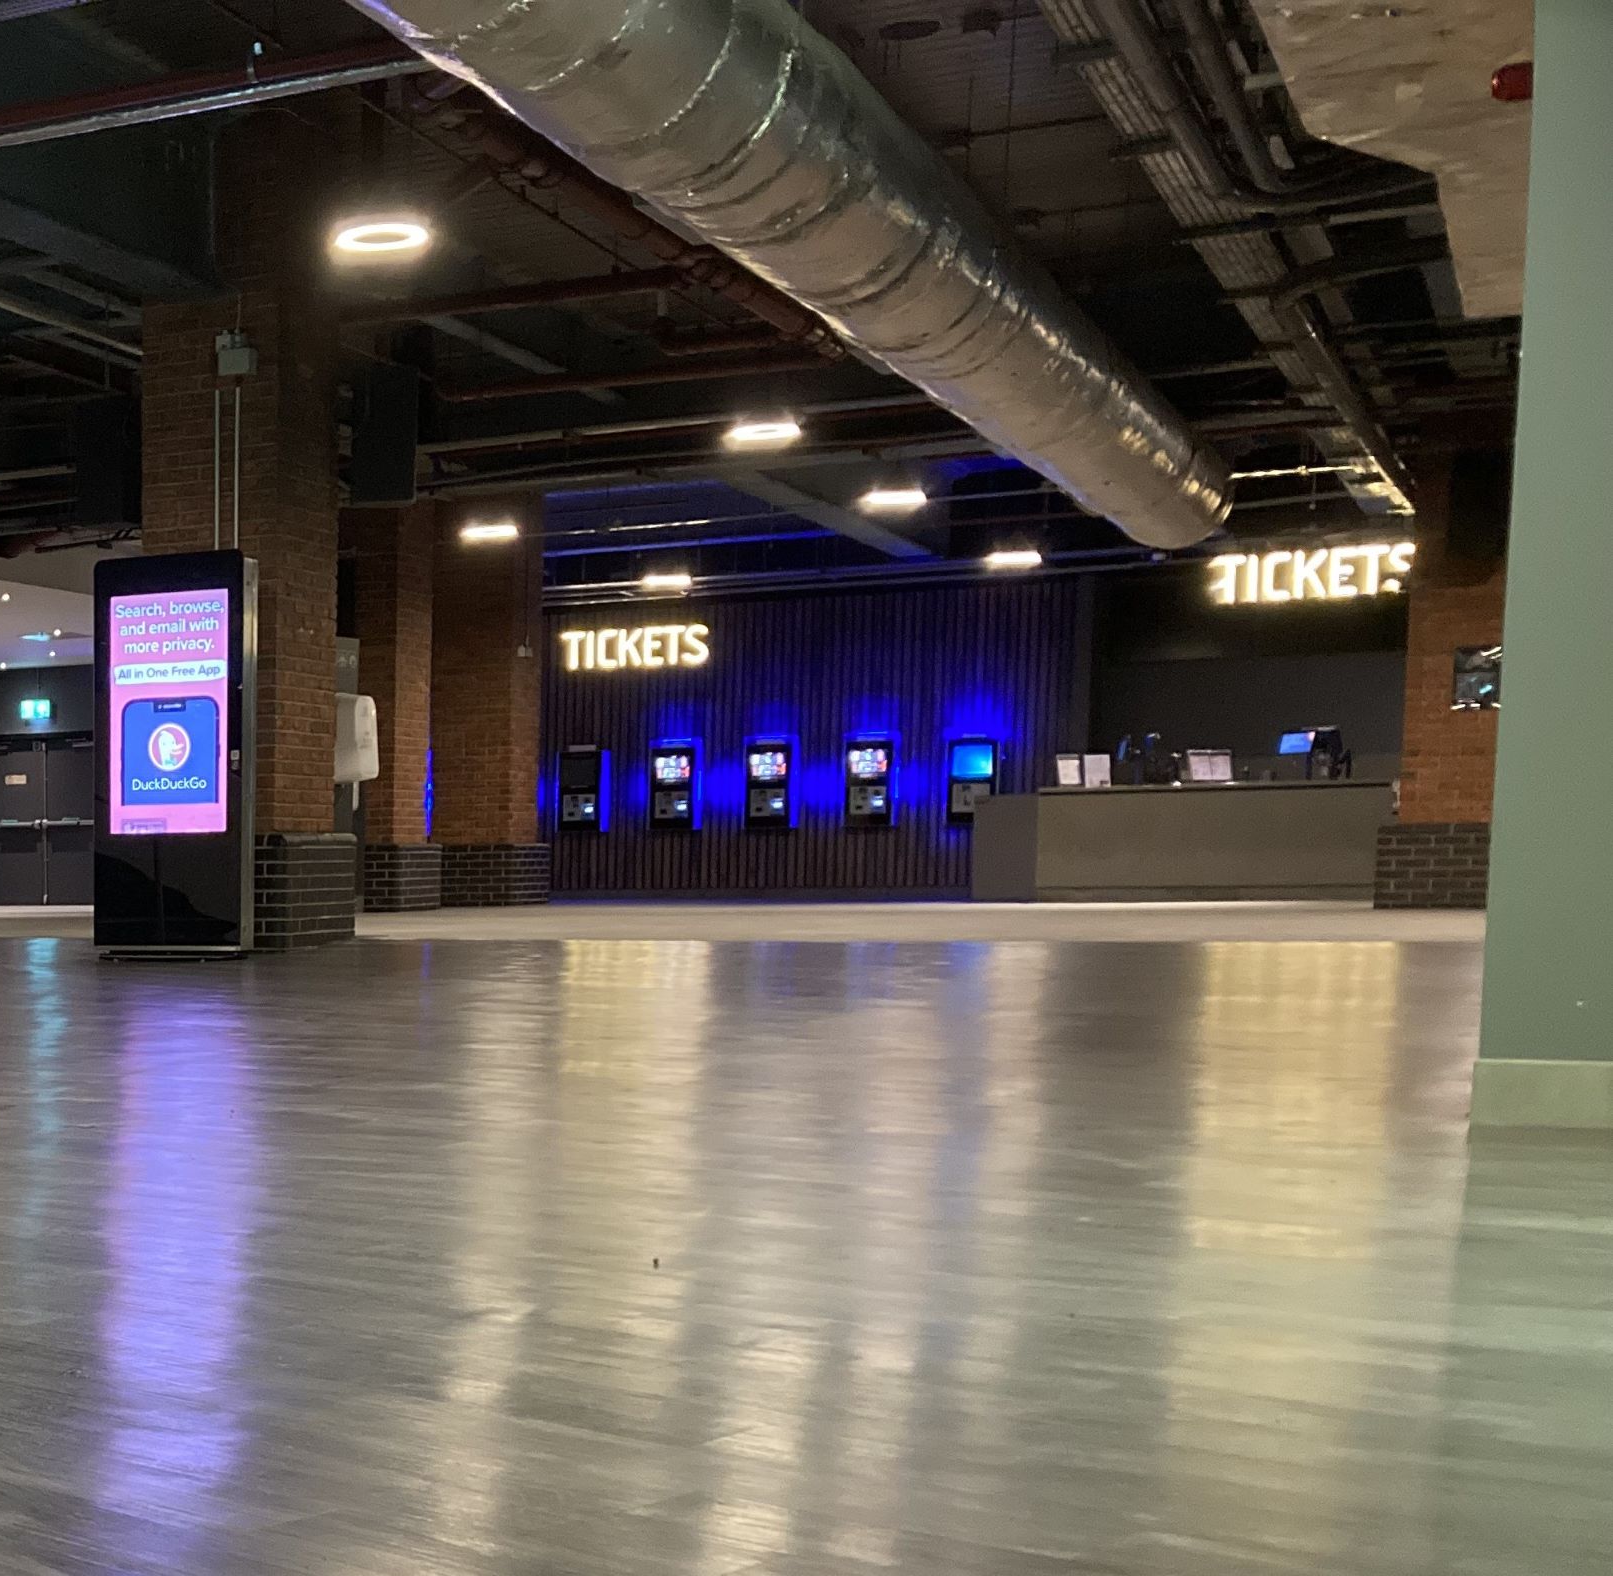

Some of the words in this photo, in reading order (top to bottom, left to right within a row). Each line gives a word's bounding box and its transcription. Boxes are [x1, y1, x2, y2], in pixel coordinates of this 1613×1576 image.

[1208, 542, 1416, 604] TICKETS
[115, 602, 166, 619] Search,
[169, 599, 225, 615] browse,
[120, 621, 145, 636] and
[149, 618, 186, 634] email
[189, 617, 219, 632] with
[124, 641, 159, 654] more
[162, 637, 215, 655] privacy.
[559, 623, 710, 671] TICKETS
[118, 667, 132, 680] All
[134, 667, 143, 679] in
[146, 667, 169, 678] One
[171, 665, 195, 676] Free
[197, 664, 220, 678] App
[132, 776, 207, 791] DuckDuckGo
